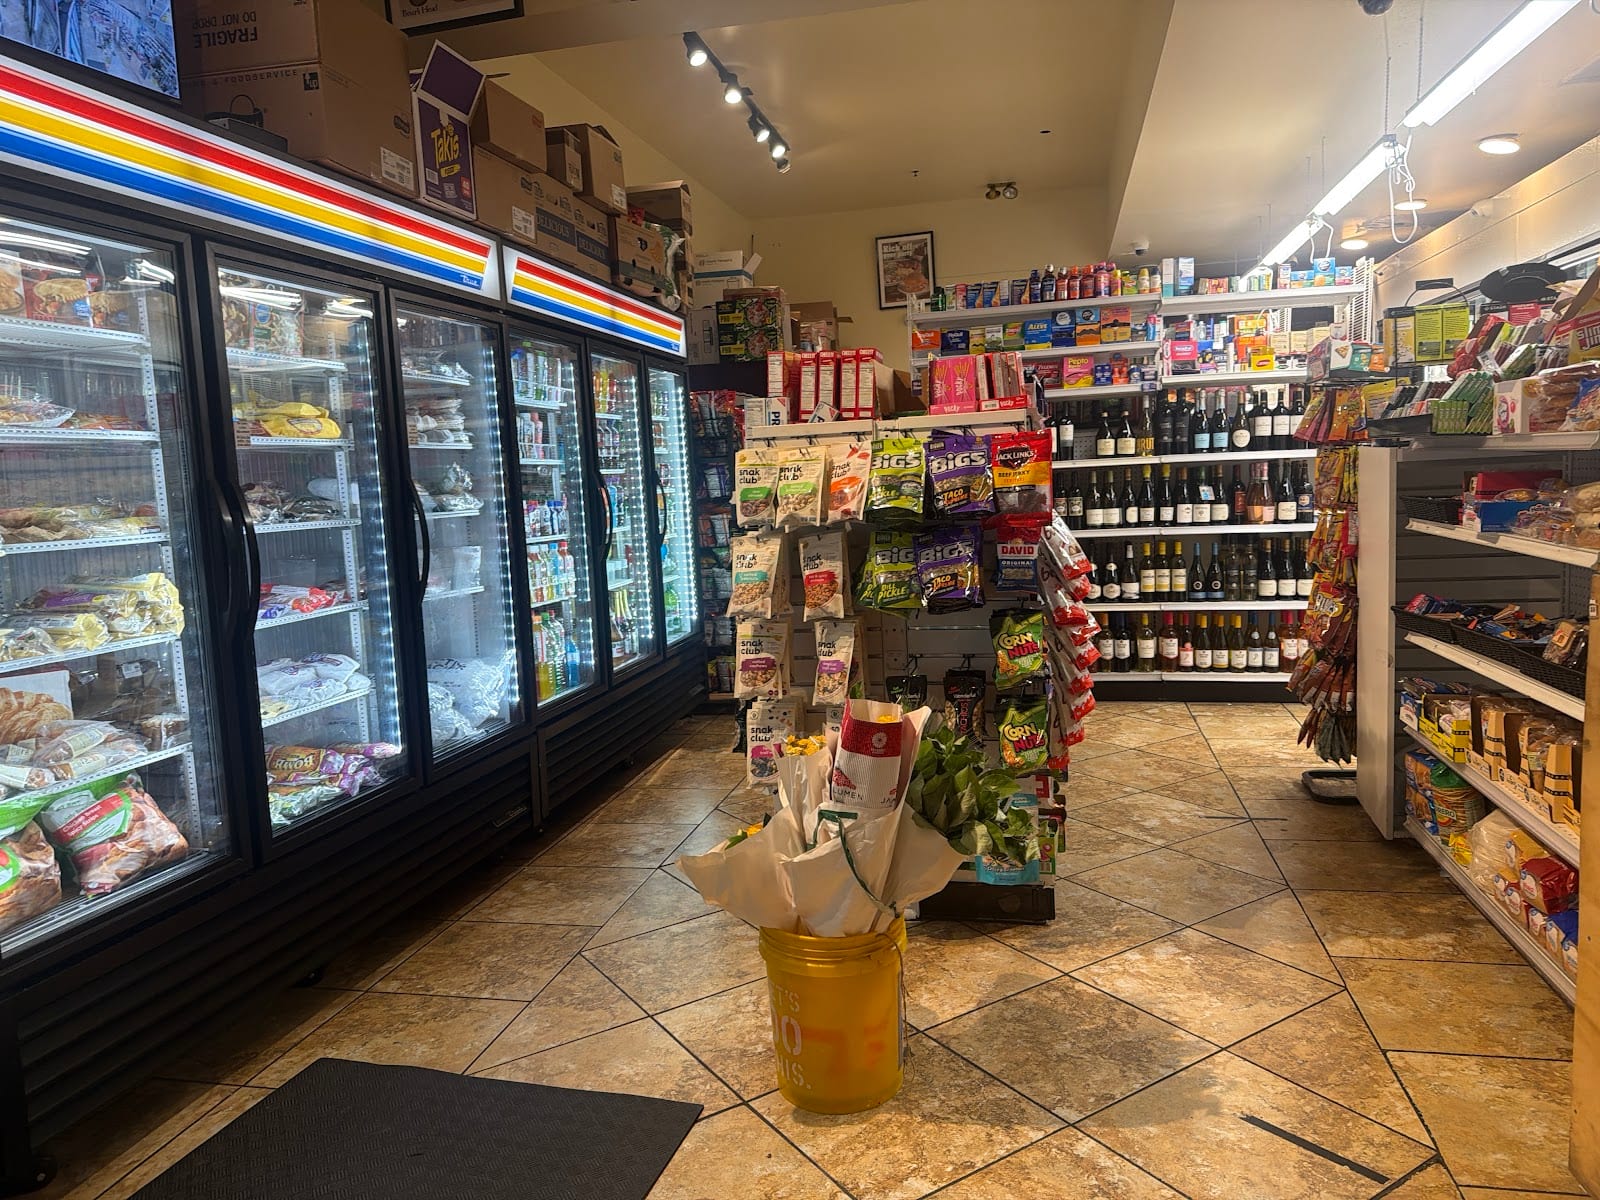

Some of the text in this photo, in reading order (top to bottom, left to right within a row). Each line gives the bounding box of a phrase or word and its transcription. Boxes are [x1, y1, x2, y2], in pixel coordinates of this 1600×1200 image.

[192, 11, 257, 30] DO NOT DROP
[194, 27, 258, 48] FRAGILE
[431, 128, 459, 169] Takis
[832, 461, 850, 471] snak
[739, 468, 761, 476] snak
[831, 470, 846, 479] club
[739, 476, 759, 484] club
[943, 488, 964, 500] TACO
[1001, 545, 1034, 555] DAVID
[933, 574, 951, 586] TACO
[881, 583, 896, 591] DILL
[878, 587, 906, 599] PICKLE
[741, 639, 764, 647] snak
[818, 640, 836, 649] snak
[998, 632, 1033, 650] CORN
[741, 647, 761, 655] club
[1008, 641, 1040, 660] NUTS
[750, 725, 773, 734] snak
[1003, 722, 1038, 741] CORN
[750, 733, 771, 742] club
[776, 1050, 812, 1090] HIS.
